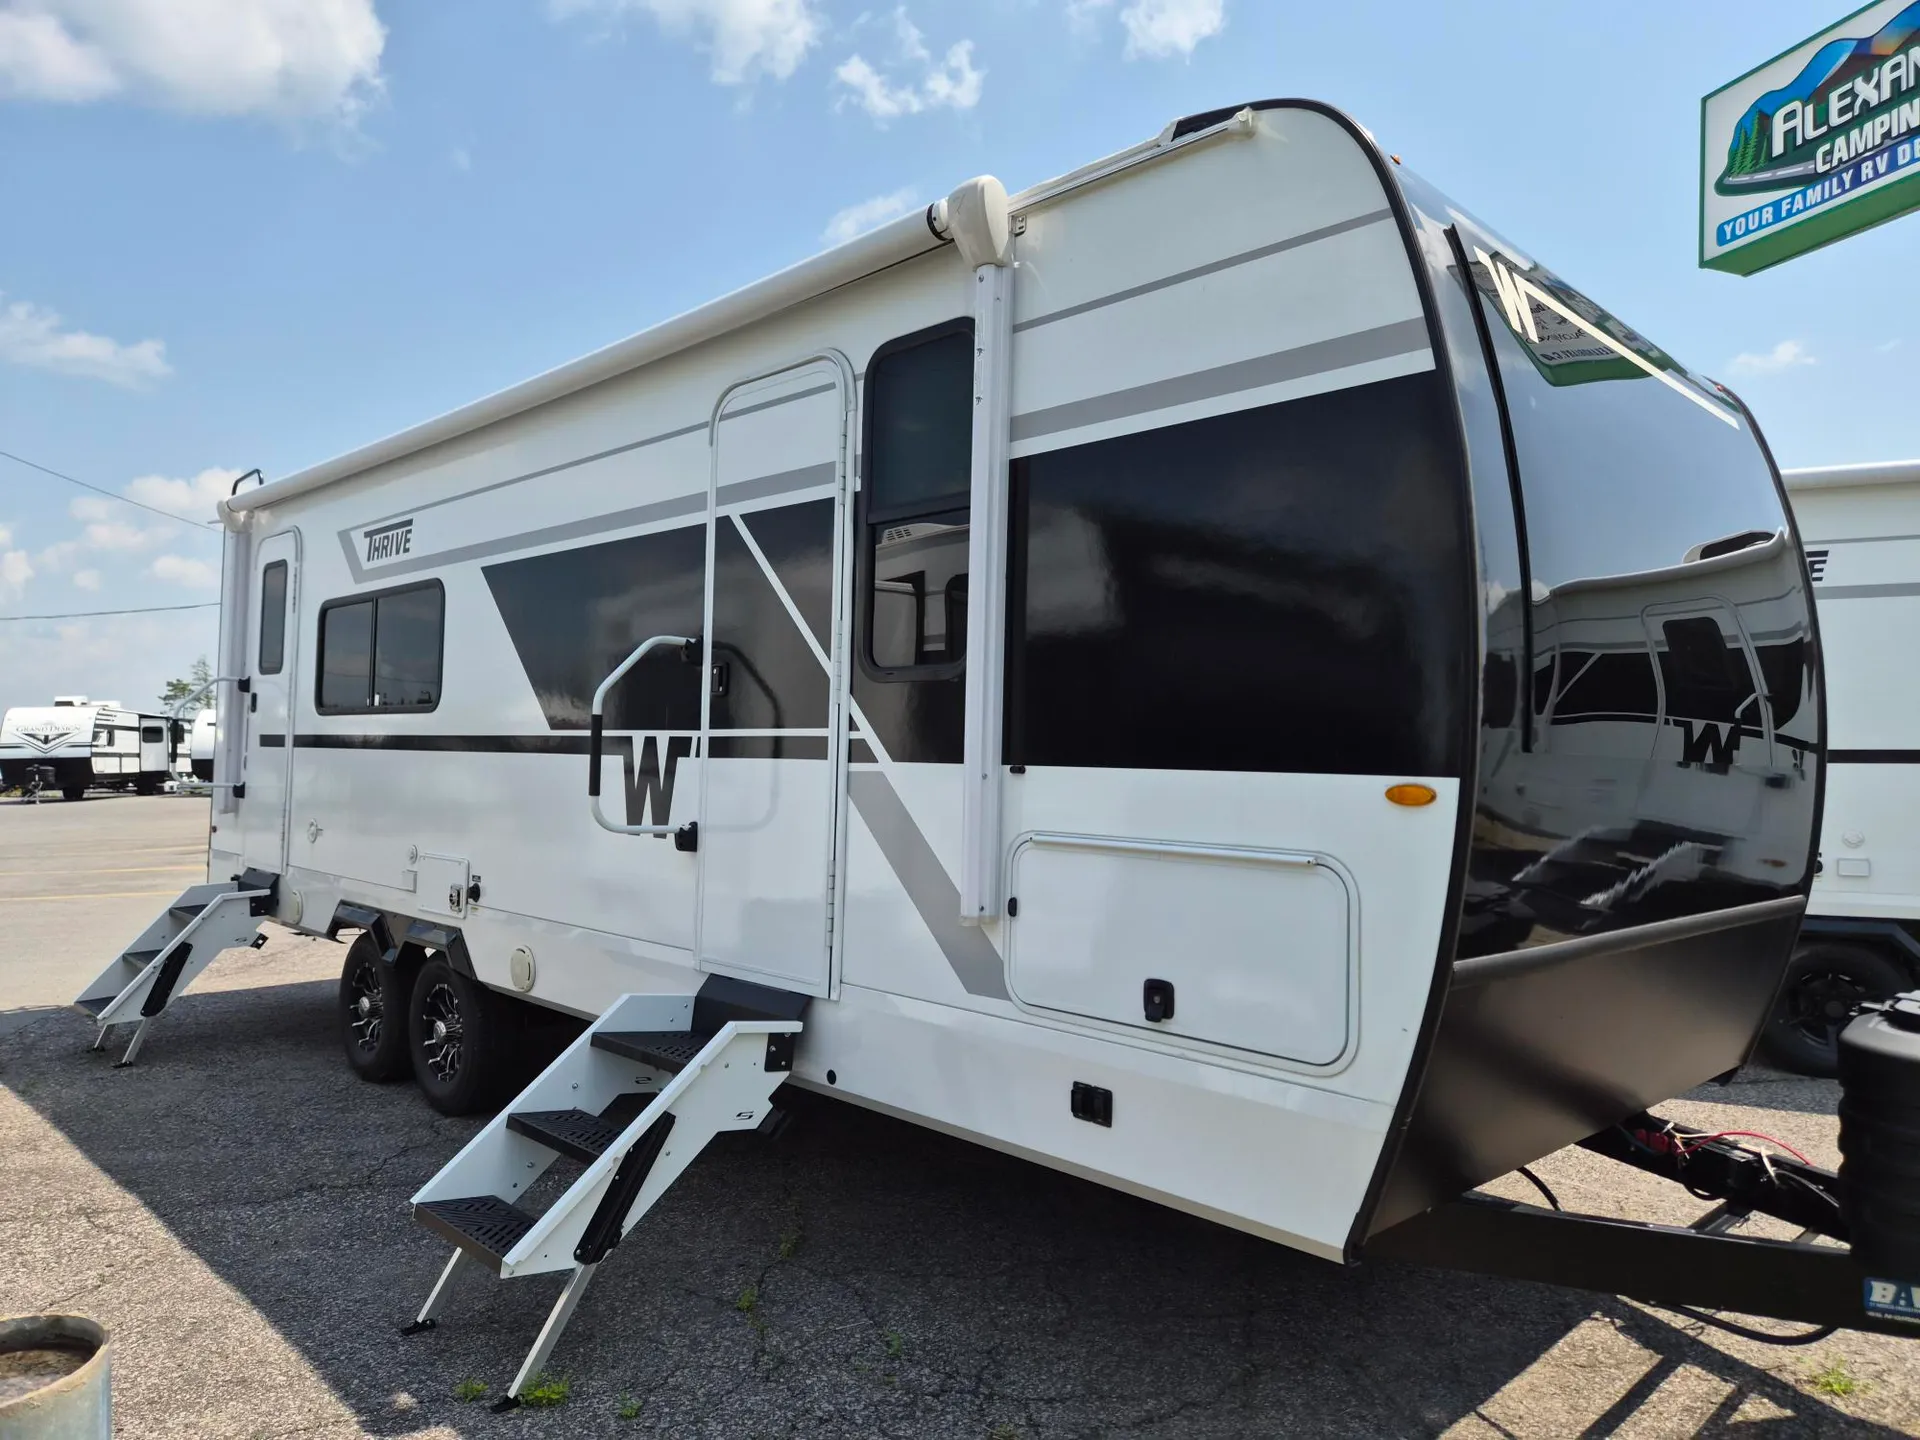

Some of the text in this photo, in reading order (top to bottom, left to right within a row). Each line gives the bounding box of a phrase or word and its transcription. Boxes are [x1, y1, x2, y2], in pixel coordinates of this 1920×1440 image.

[1723, 208, 1773, 241] YOUR
[1781, 169, 1853, 218] FAMILY
[1860, 151, 1888, 182] RV
[363, 518, 413, 562] THRIVE
